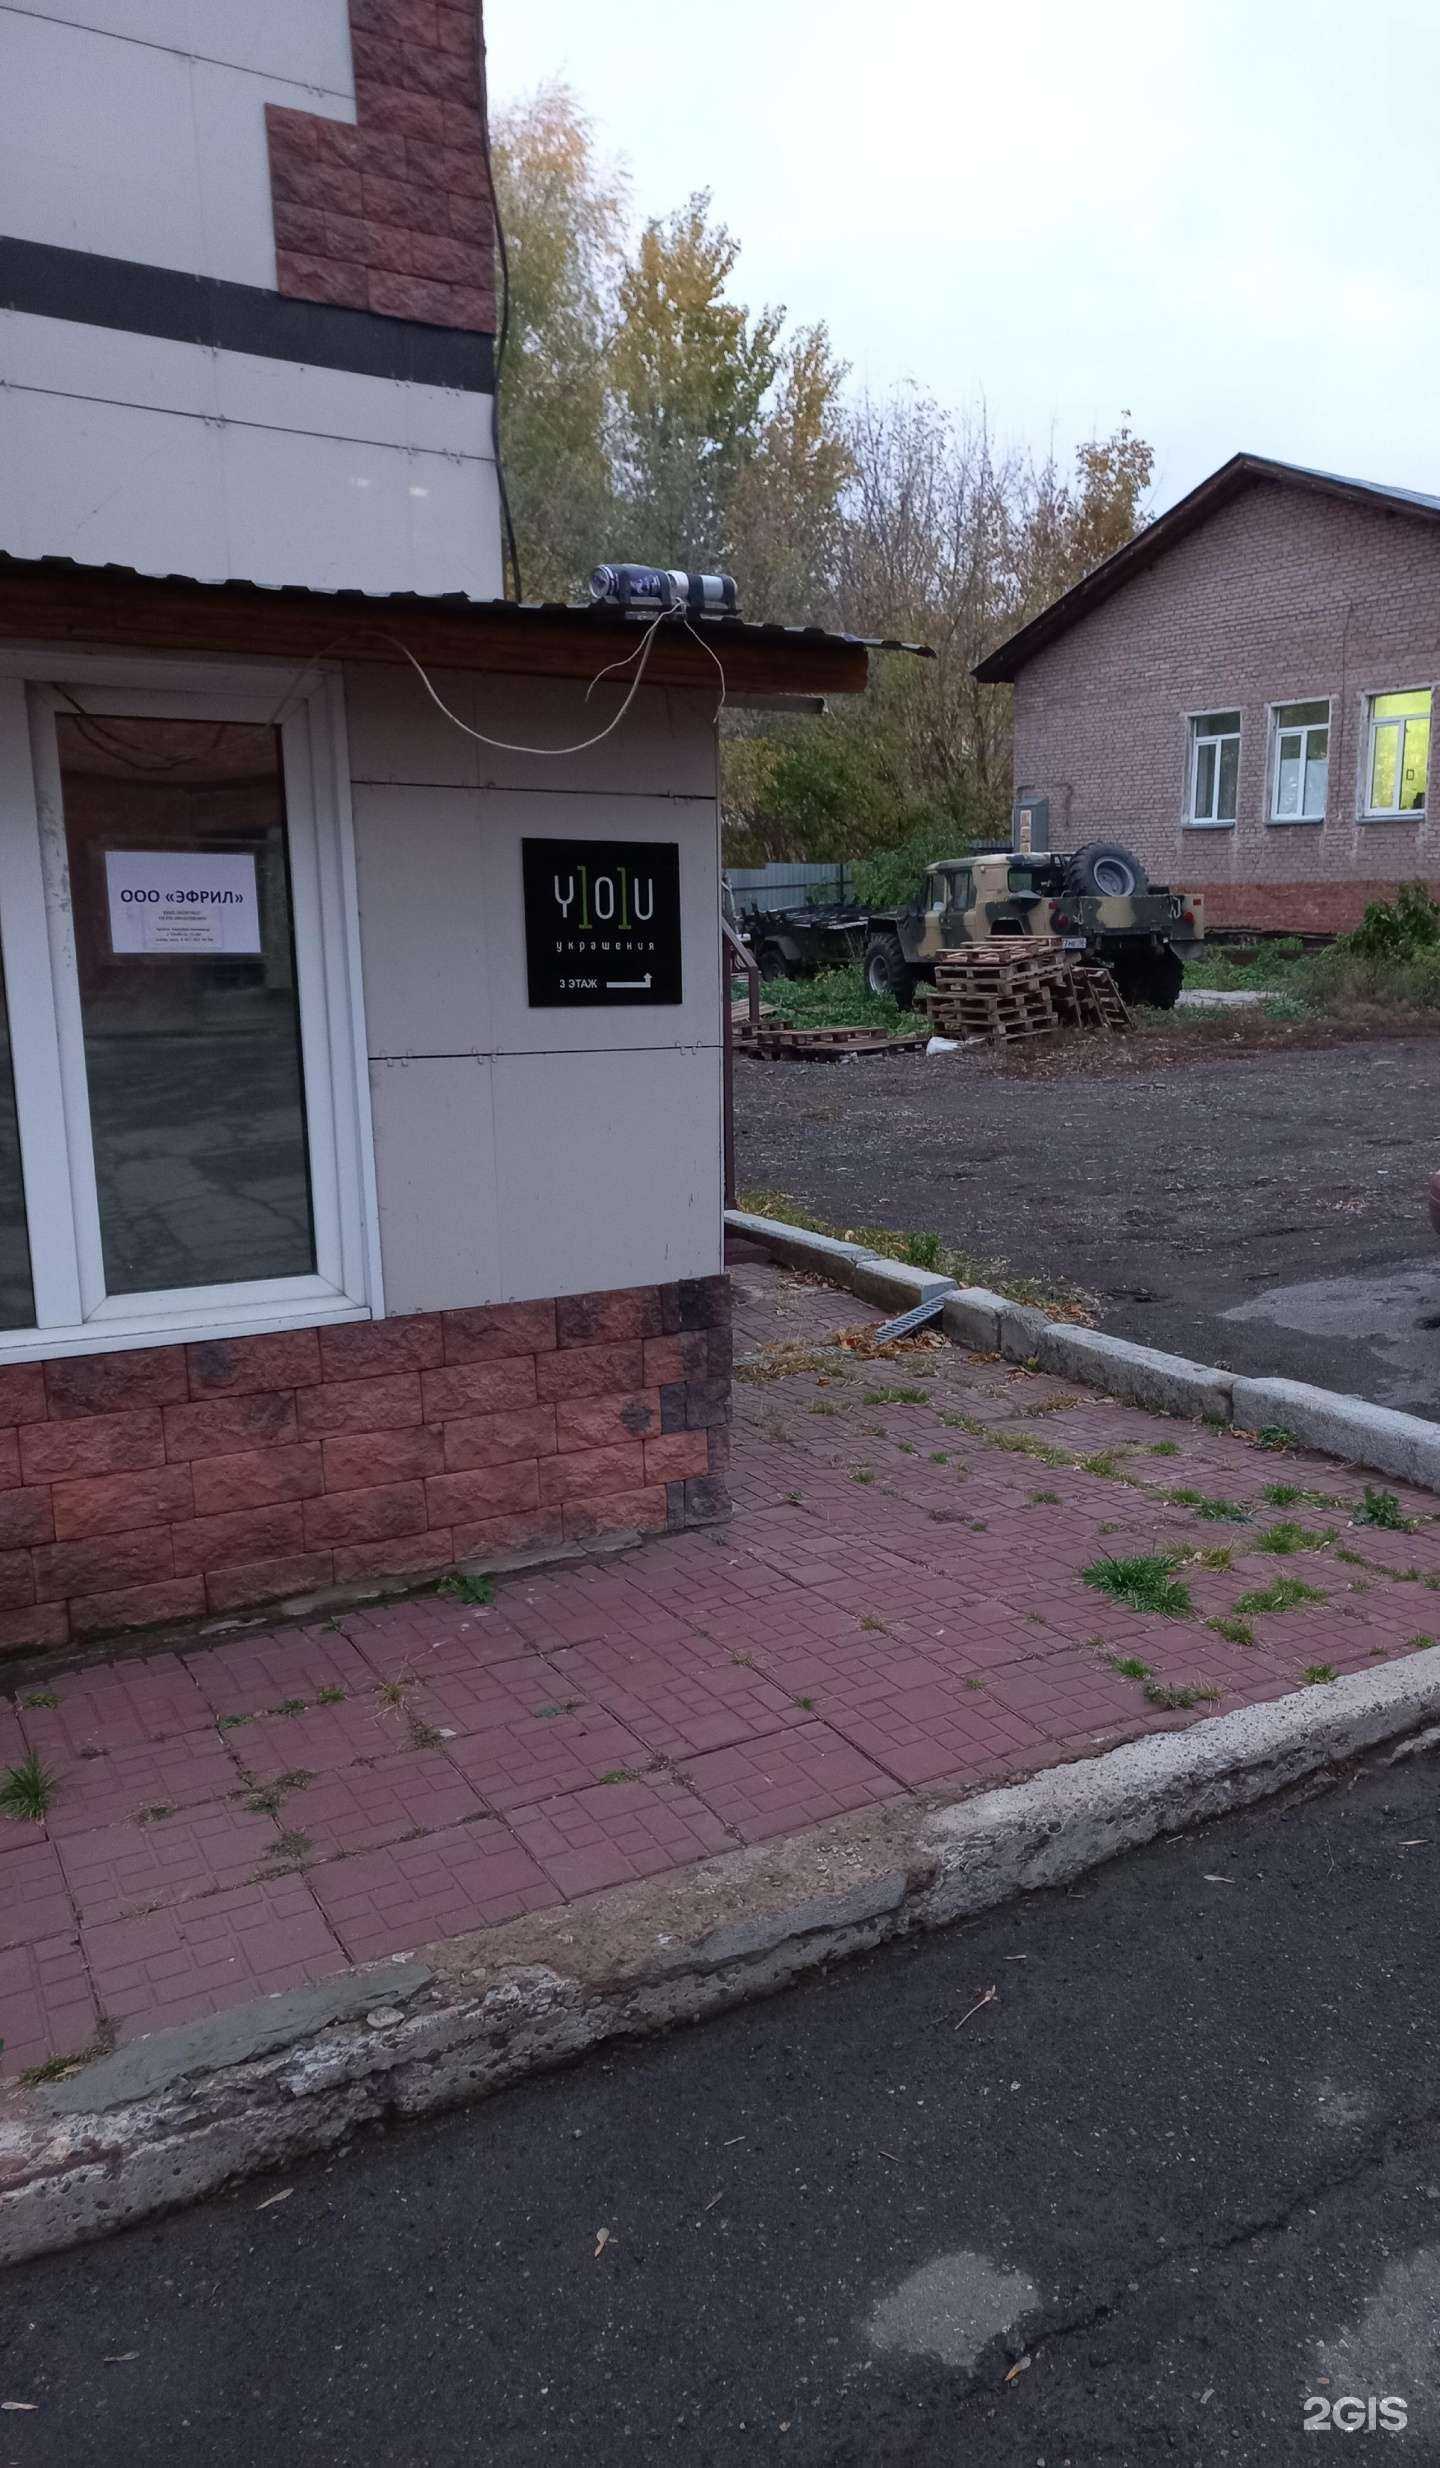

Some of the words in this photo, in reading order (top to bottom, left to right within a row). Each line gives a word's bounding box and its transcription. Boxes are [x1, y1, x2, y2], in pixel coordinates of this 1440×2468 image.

[120, 889, 160, 903] ООО
[165, 889, 244, 904] «ЭФРИЛ»
[556, 941, 655, 953] украшения
[559, 979, 566, 989] 3
[568, 979, 597, 989] ЭТАЖ
